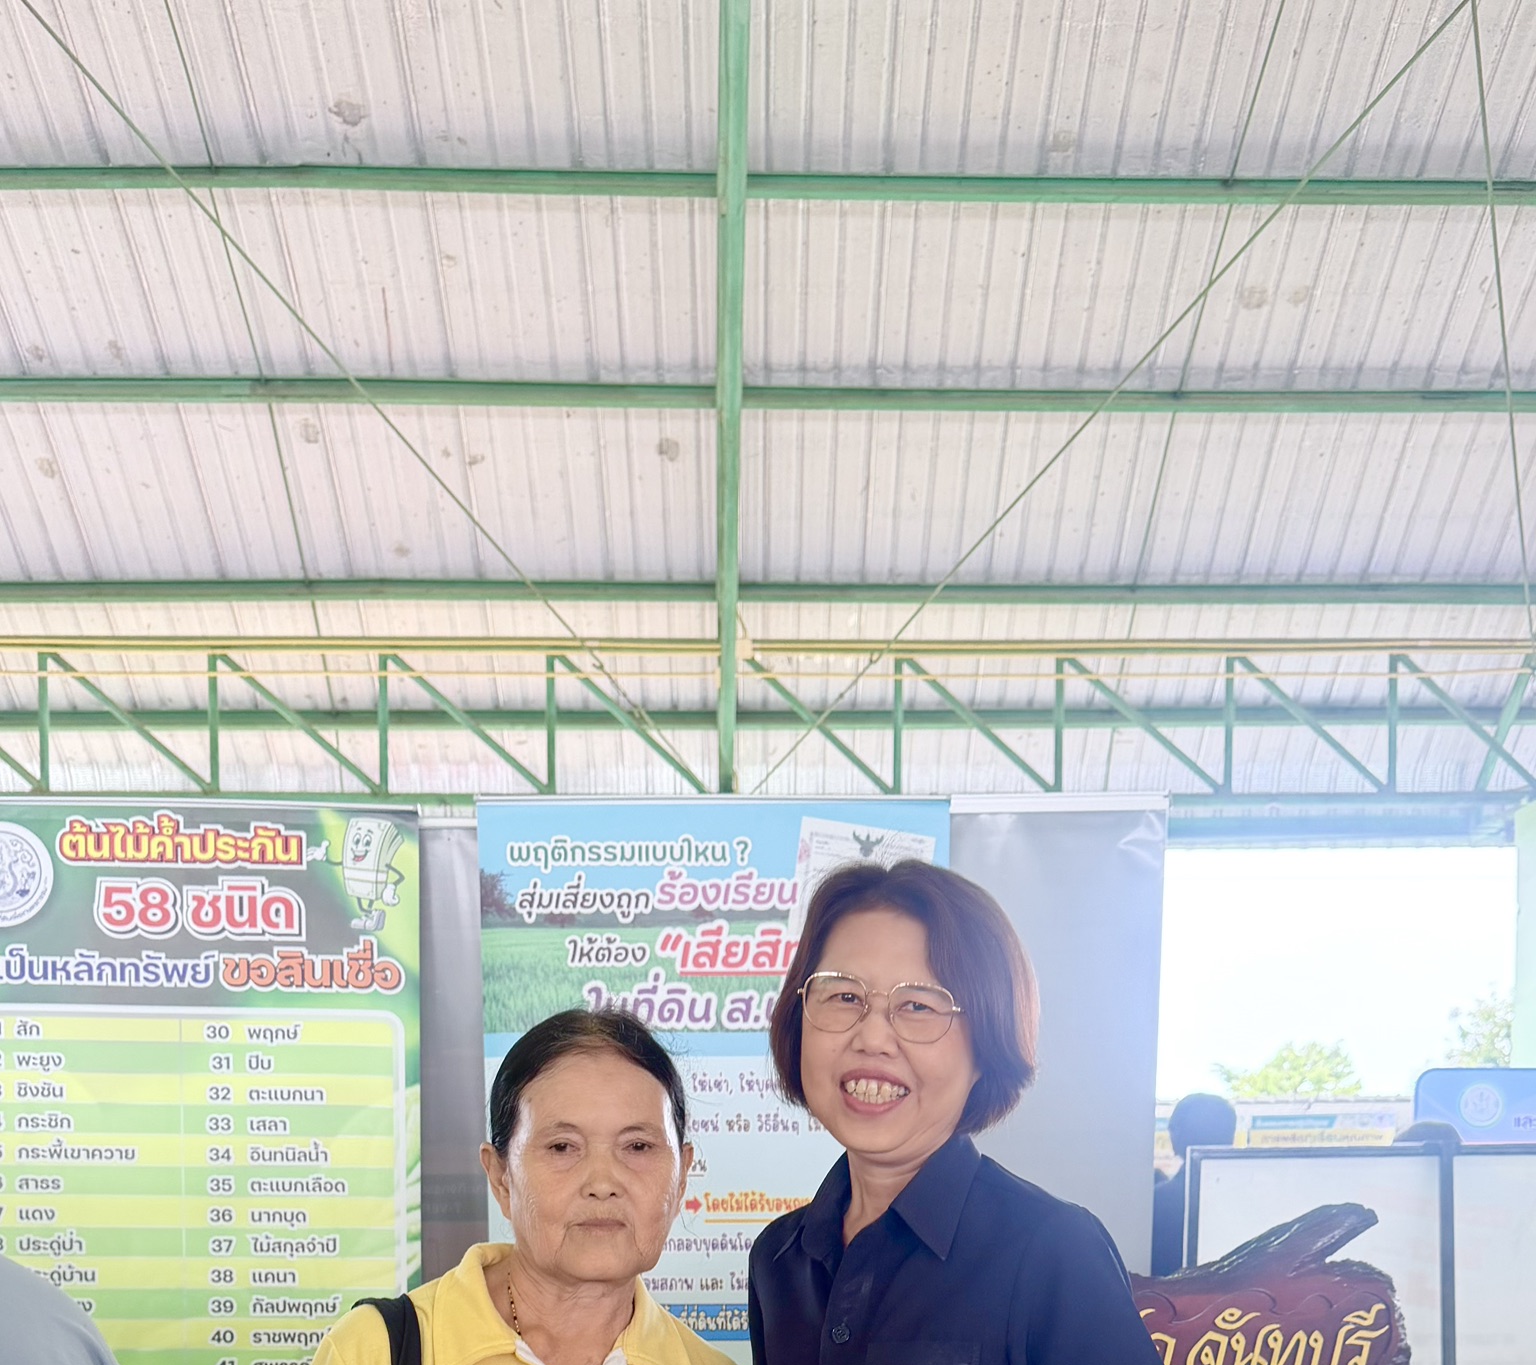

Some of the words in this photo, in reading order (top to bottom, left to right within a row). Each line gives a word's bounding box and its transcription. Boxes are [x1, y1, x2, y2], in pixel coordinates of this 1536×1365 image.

[59, 814, 303, 866] ต้นไม้ค้ำประกัน
[509, 838, 727, 870] พฤติกรรมแบบไหน
[735, 840, 749, 863] ?
[518, 874, 651, 919] สุ่มเสี่ยงถูก
[657, 870, 798, 906] ร้องเรียน
[103, 886, 172, 928] 58
[190, 885, 295, 930] ชนิด
[568, 936, 647, 964] ให้ต้อง
[223, 939, 402, 991] ขอสินเชื่อ
[16, 1020, 41, 1037] สัก
[206, 1025, 230, 1040] 30
[248, 1024, 301, 1043] พฤกษ์
[16, 1055, 63, 1072] พะยูง
[212, 1056, 231, 1070] 31
[248, 1054, 272, 1070] ปีบ
[17, 1081, 64, 1098] ชิงชัน
[209, 1087, 231, 1101] 32
[249, 1089, 324, 1101] ตะแบกนา
[209, 1117, 232, 1132] 33
[250, 1119, 287, 1132] เสลา
[18, 1138, 136, 1160] กระพี้เขาควาย
[209, 1148, 232, 1162] 34
[250, 1141, 328, 1162] อินทนิลน้ำ
[18, 1177, 61, 1190] สาธร
[210, 1178, 232, 1193] 35
[250, 1177, 346, 1193] ตะแบกเลือด
[19, 1208, 56, 1221] แดง
[210, 1208, 233, 1223] 36
[251, 1211, 307, 1228] นากบุด
[19, 1231, 83, 1257] ประดู่ป่า
[211, 1239, 232, 1254] 37
[252, 1234, 337, 1257] ไม้สกุลจำปี
[211, 1269, 233, 1284] 38
[252, 1271, 296, 1284] แคนา
[700, 1277, 723, 1291] และ
[211, 1299, 234, 1314] 39
[252, 1296, 340, 1319] กัลปพฤกษ์
[211, 1330, 234, 1344] 40
